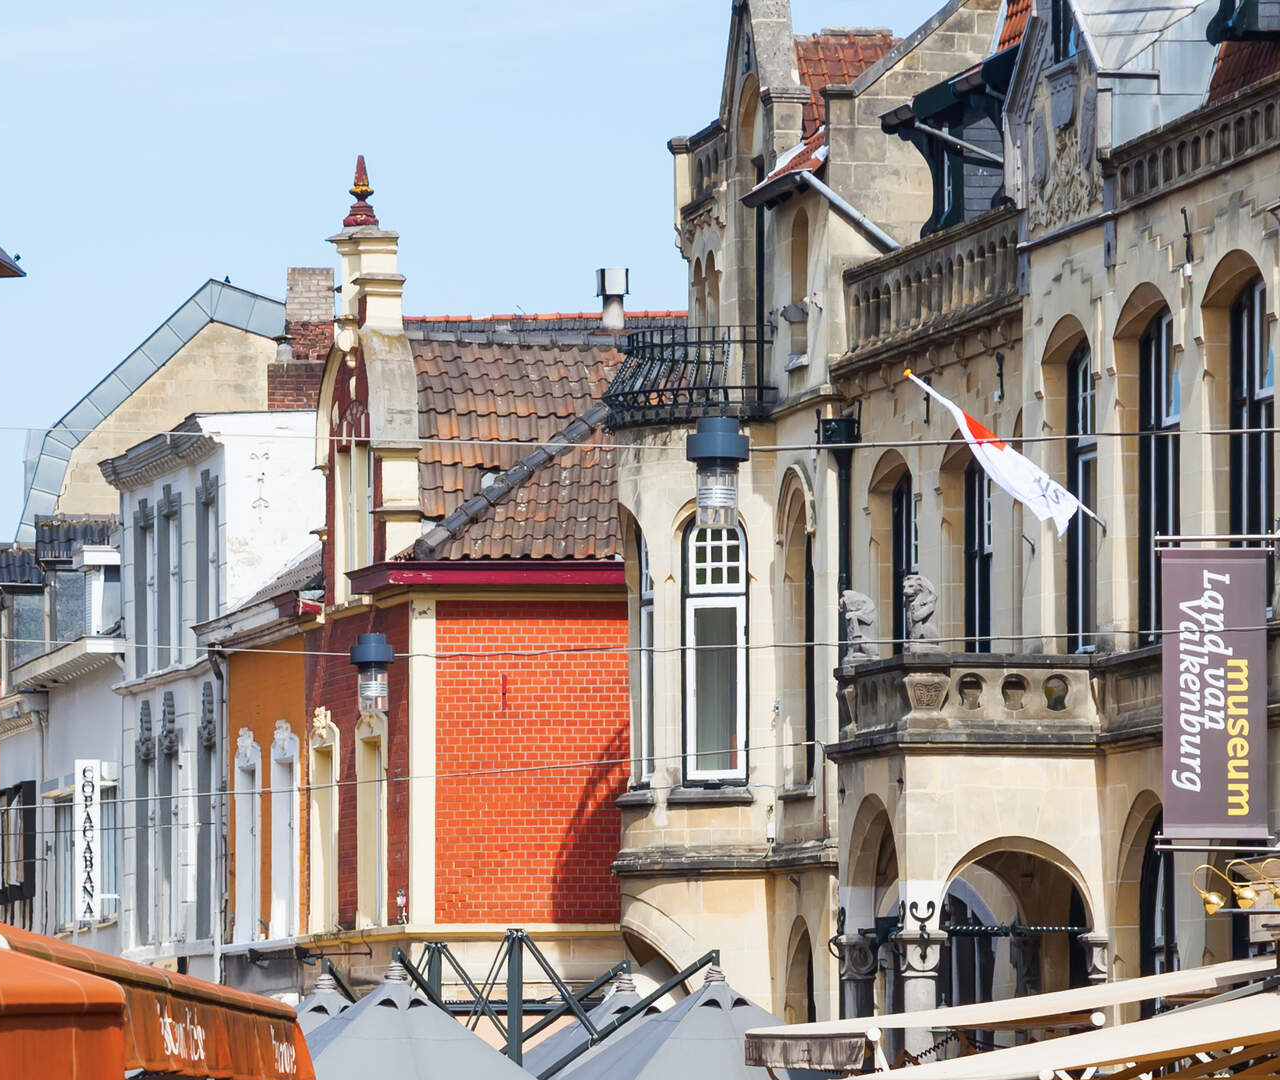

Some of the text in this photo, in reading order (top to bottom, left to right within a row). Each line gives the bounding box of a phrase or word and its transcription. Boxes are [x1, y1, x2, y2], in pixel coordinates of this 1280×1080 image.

[1171, 599, 1209, 792] Valkenburg
[1203, 569, 1233, 730] Land van
[1227, 658, 1250, 817] museum
[81, 766, 95, 918] COPACABANA
